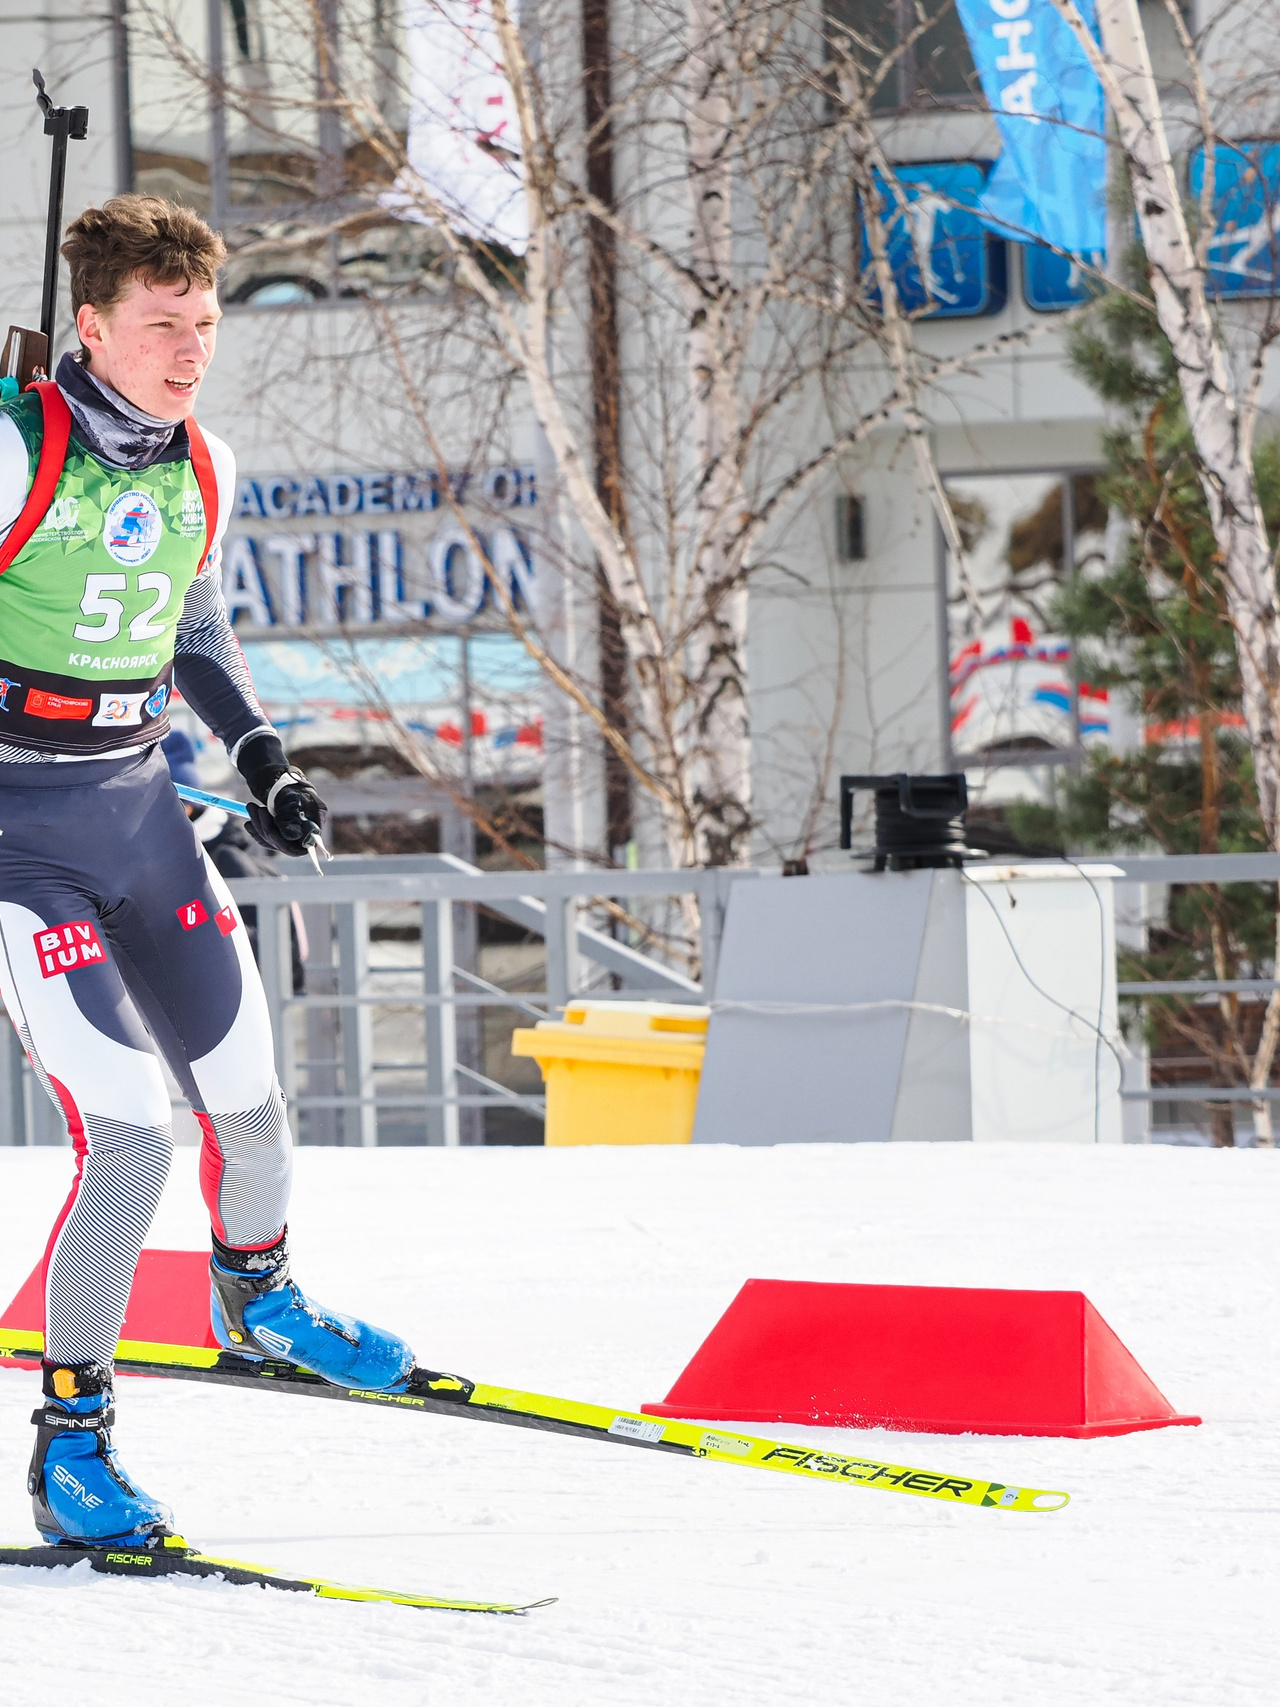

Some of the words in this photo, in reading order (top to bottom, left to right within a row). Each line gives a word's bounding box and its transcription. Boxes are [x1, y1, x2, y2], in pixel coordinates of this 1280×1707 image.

[224, 522, 538, 627] ATHLON
[73, 571, 173, 643] 52
[68, 652, 159, 670] КРАСНОЯРСК
[348, 1389, 425, 1407] FISCHER
[44, 1414, 99, 1428] SPINE
[53, 1464, 104, 1509] SPINE
[761, 1446, 973, 1498] FISCHER
[105, 1553, 153, 1566] FISCHER
